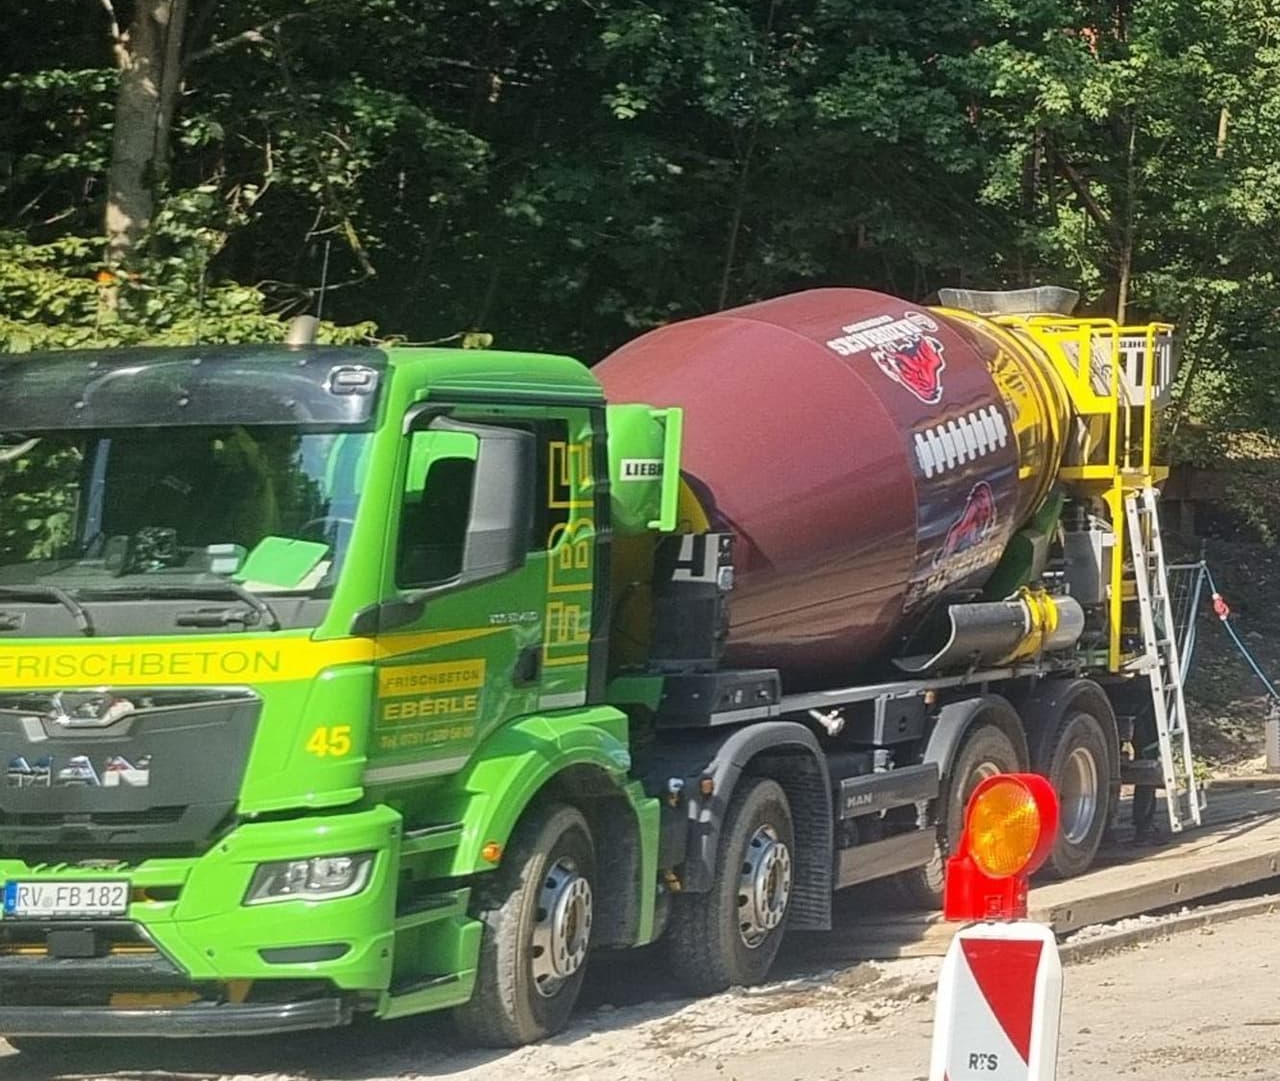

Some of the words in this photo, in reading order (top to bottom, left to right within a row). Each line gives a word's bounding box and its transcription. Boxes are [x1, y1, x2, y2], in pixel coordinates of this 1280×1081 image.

[384, 695, 478, 721] EBERLE
[305, 725, 352, 758] 45
[7, 754, 152, 787] MAN
[18, 887, 43, 906] RV
[56, 887, 81, 906] FB
[86, 887, 123, 906] 182
[968, 1053, 998, 1071] RTS
